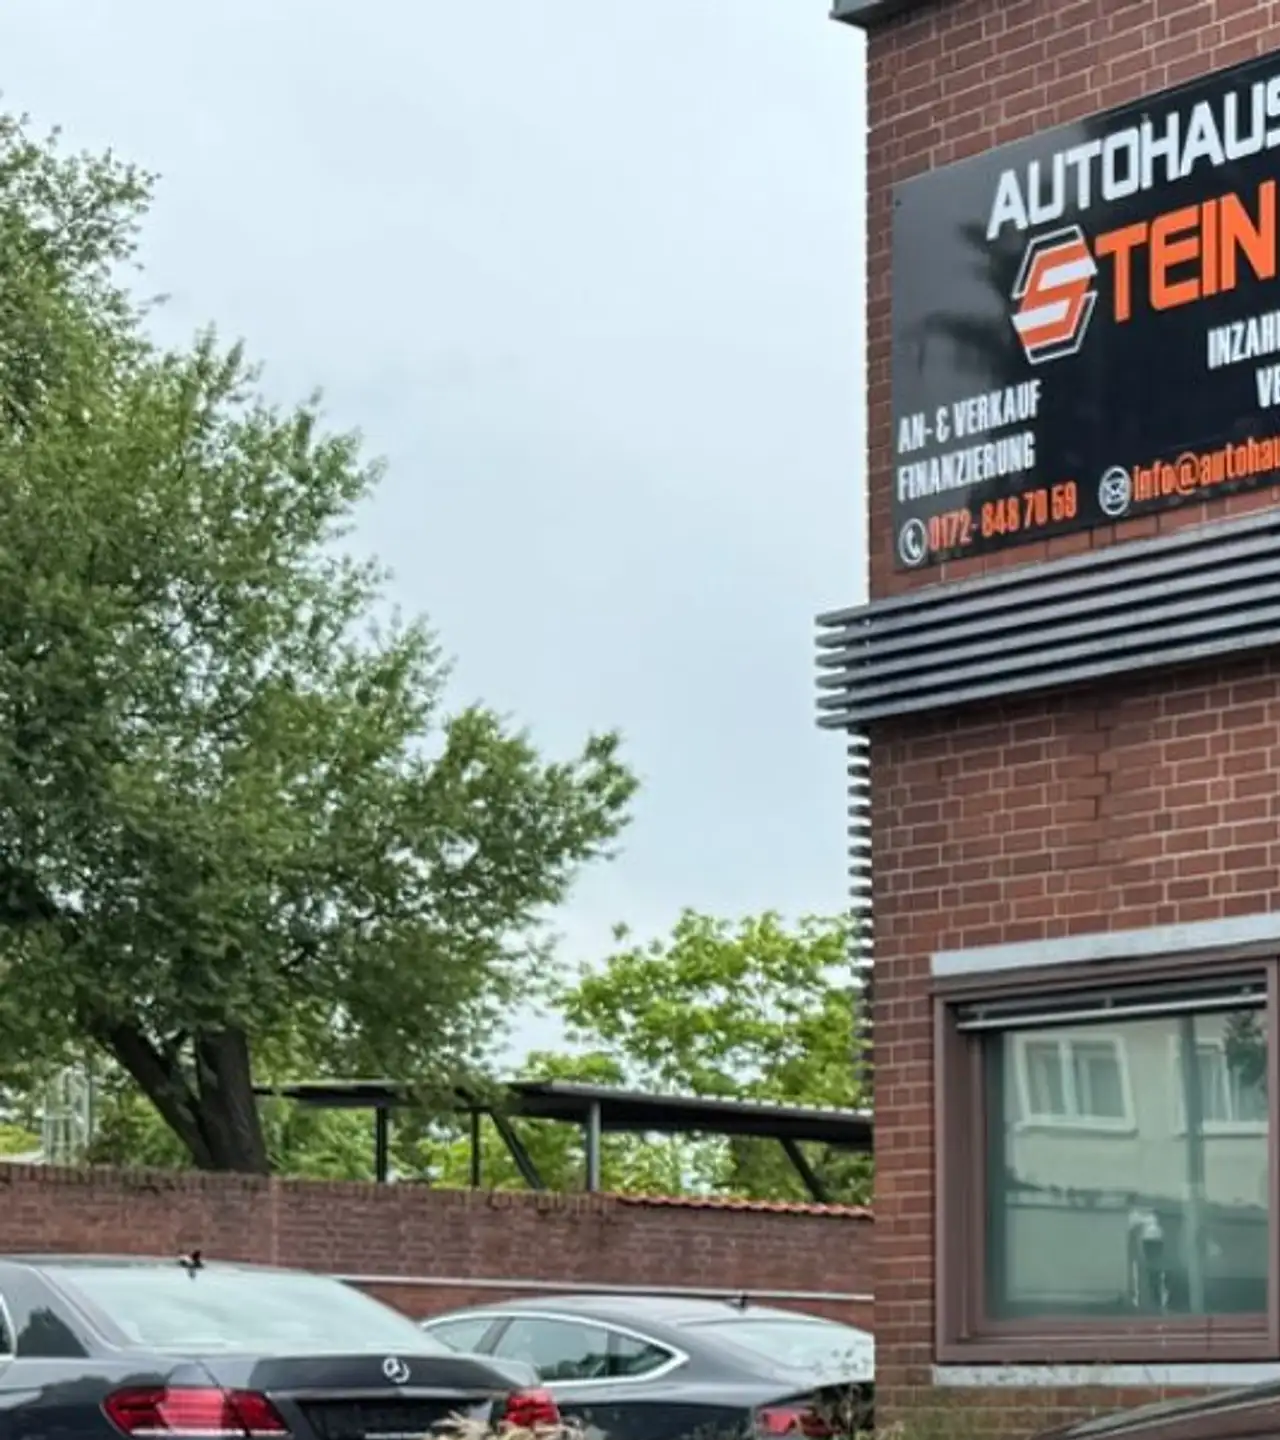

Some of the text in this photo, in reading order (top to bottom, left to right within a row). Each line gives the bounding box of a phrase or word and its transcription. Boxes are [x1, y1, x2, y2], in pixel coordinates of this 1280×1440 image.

[1012, 180, 1276, 355] STEIN
[897, 413, 933, 454] AN-
[952, 379, 1042, 438] VERKAUF
[897, 432, 1036, 503] FINANZIERUNG
